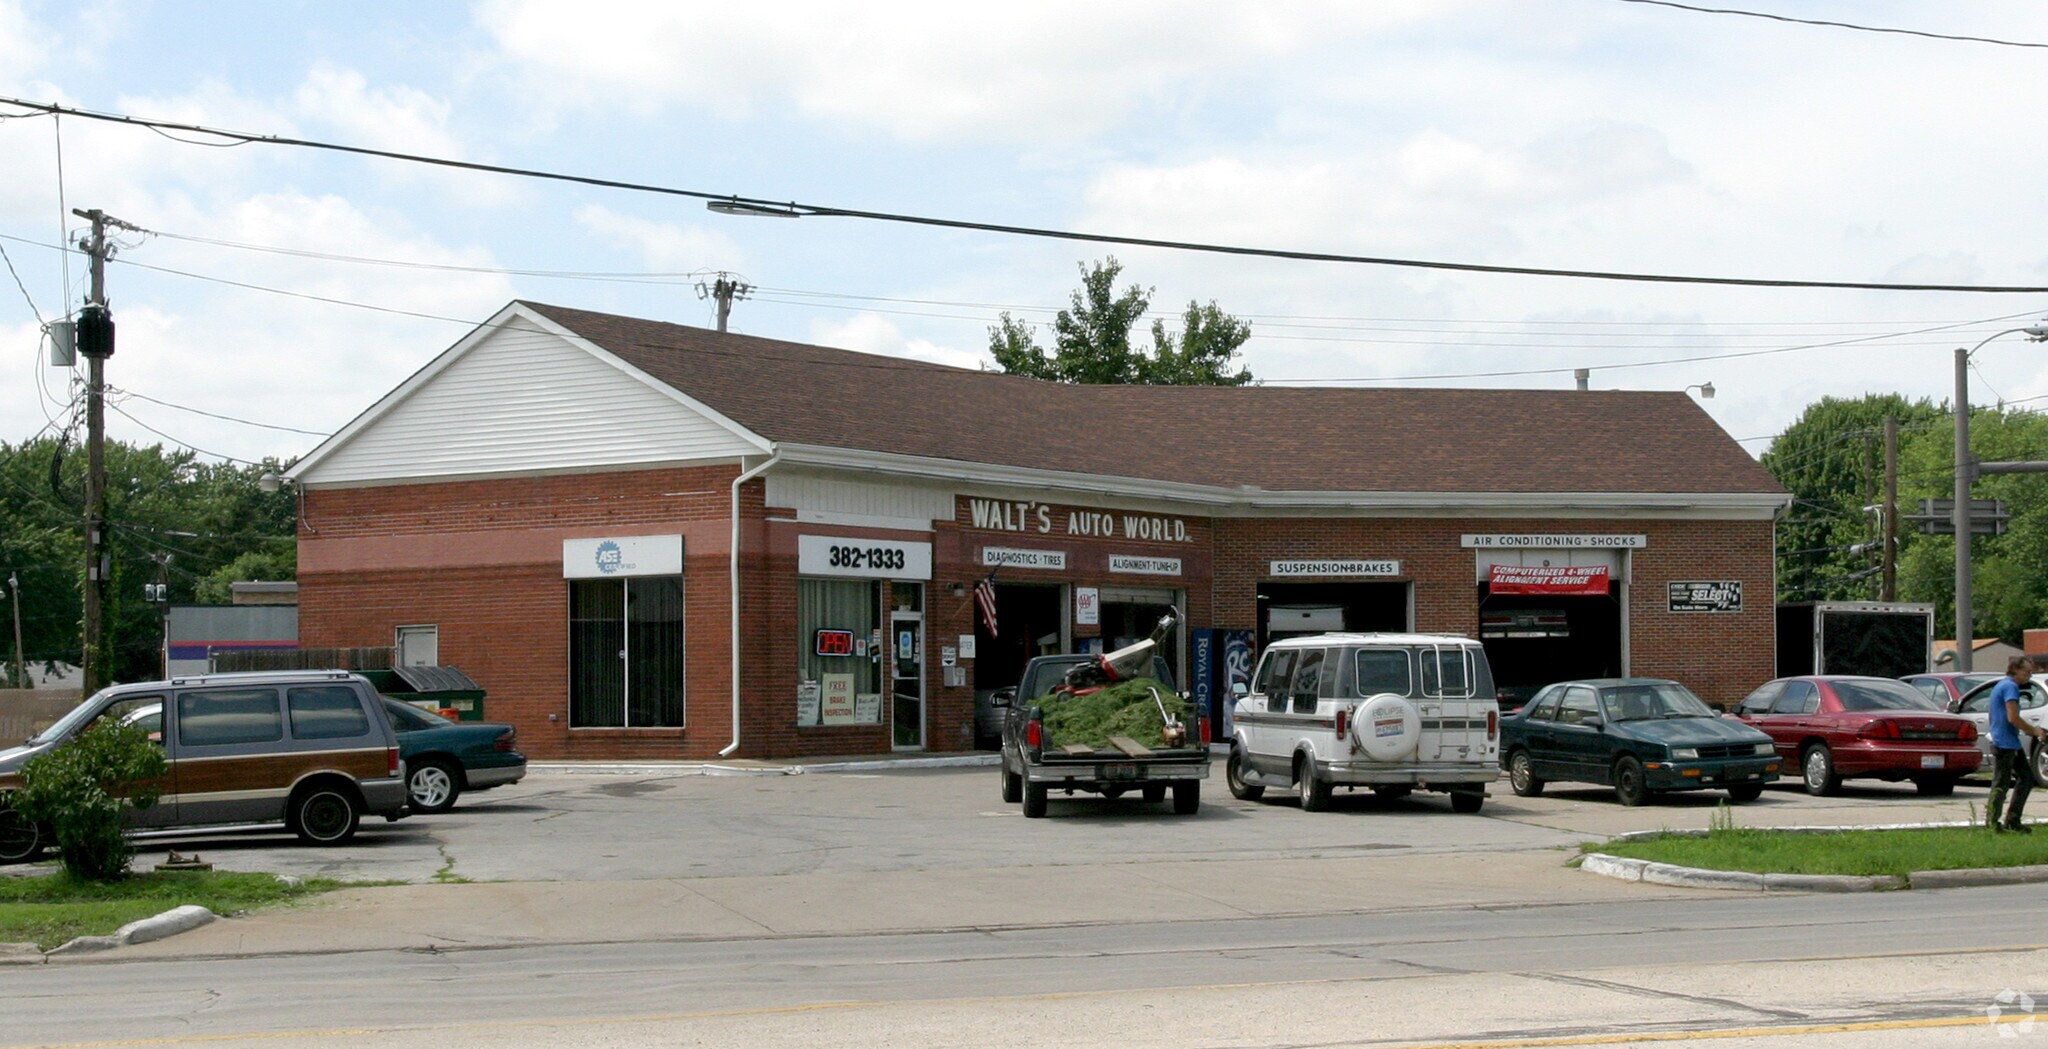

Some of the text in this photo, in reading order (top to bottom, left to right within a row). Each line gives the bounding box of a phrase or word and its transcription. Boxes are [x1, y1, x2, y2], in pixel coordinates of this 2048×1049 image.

[970, 499, 1051, 534] WALT'S
[1067, 511, 1114, 537] AUTO
[1123, 515, 1185, 542] WORLD
[1473, 536, 1636, 546] AIR CONDITIONING SHOCKS
[598, 550, 618, 563] ASE
[829, 545, 905, 570] 382-1333
[987, 551, 1062, 566] DIAGNOSTICS TIRES
[1493, 566, 1566, 576] COMPUTERIZED
[1492, 575, 1590, 585] ALIGNMENT SERVICE
[1691, 589, 1730, 601] SELECT
[819, 633, 852, 654] OPEN
[1198, 638, 1208, 680] ROYAL
[829, 681, 847, 690] FREE
